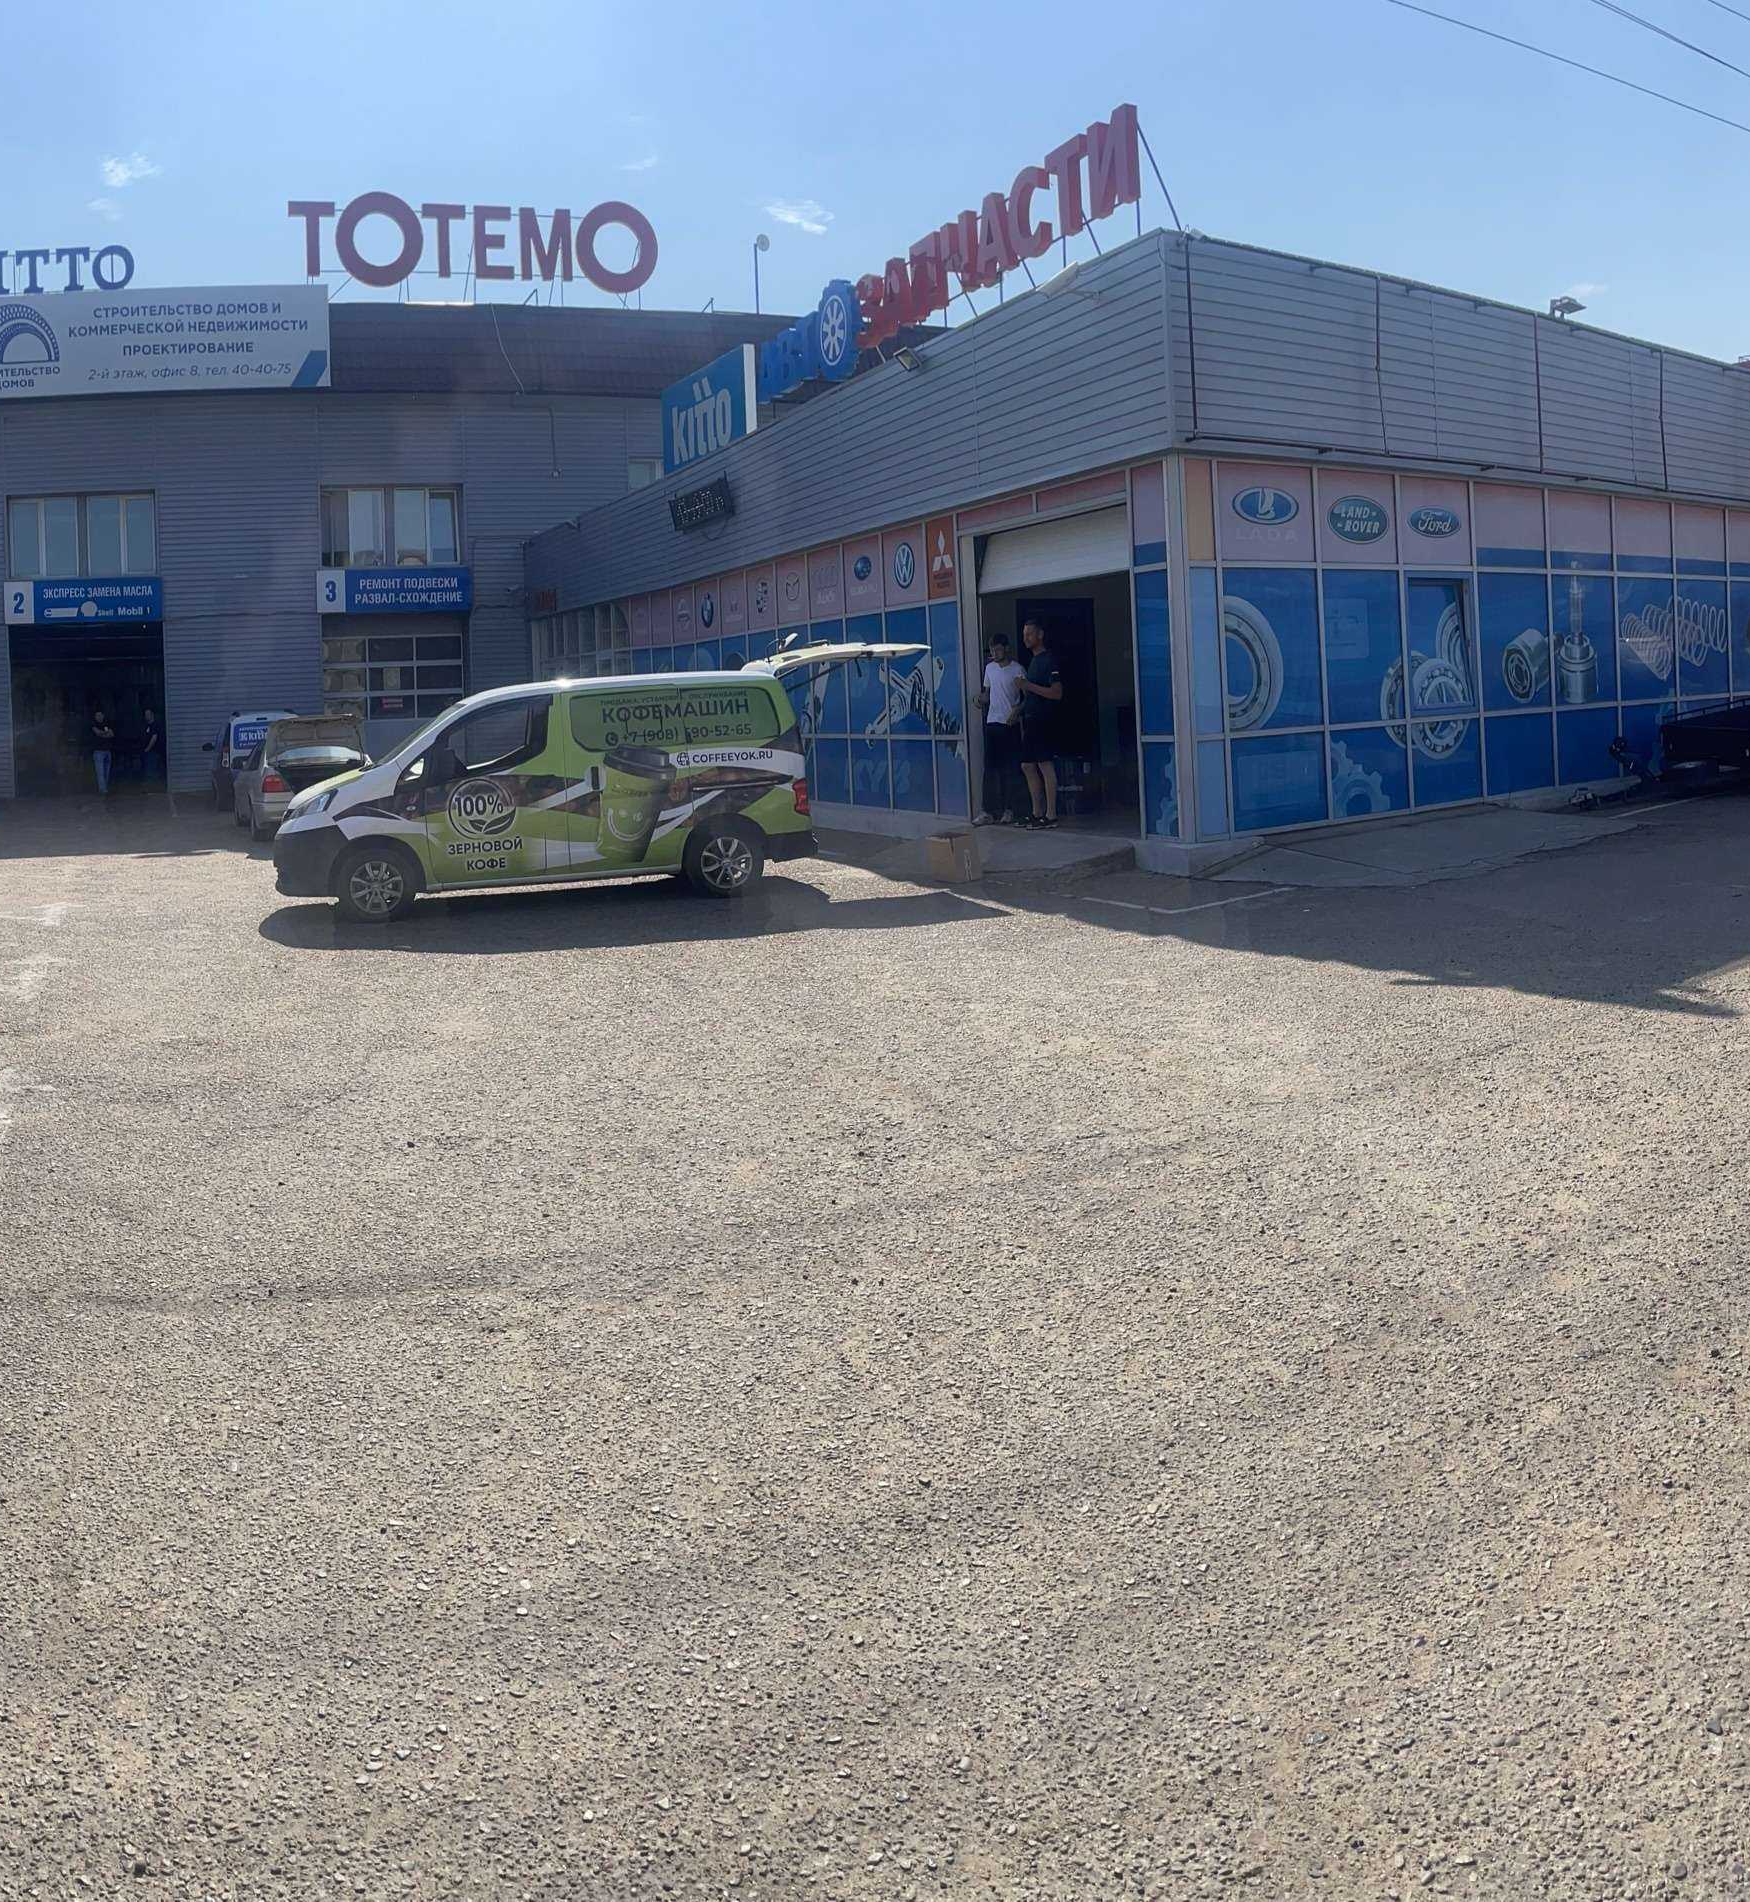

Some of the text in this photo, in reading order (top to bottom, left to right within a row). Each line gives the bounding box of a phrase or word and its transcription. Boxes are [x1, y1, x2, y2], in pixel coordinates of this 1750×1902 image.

[93, 302, 281, 318] СТРОИТЕЛЬСТВО ДОМОВ И
[68, 320, 308, 337] КОММЕРЧЕСКОЙ НЕДВИЖИМОСТИ
[123, 342, 253, 356] ПРОЕКТИРОВАНИЕ
[151, 366, 186, 379] офис
[231, 363, 292, 376] 40-40-75
[1341, 504, 1369, 518] LAND
[1344, 521, 1380, 534] ROVER
[1417, 510, 1452, 532] Ford
[1236, 526, 1298, 543] LADA
[325, 580, 337, 603] 3
[359, 577, 458, 590] РЕМОНТ ПОДВЕСКИ
[43, 585, 153, 599] ЭКСПРЕСС ЗАМЕНА МАСЛА
[355, 591, 463, 604] РАЗВАЛ-СХОЖДЕНИЕ
[13, 592, 25, 614] 2
[118, 606, 143, 616] Mobil
[602, 698, 750, 723] КОФЕМАШИН
[692, 750, 773, 763] COFFEEYOK.RU
[454, 793, 503, 817] 100%
[448, 836, 523, 855] ЗЕРНОВОЙ
[467, 858, 506, 871] КОФЕ
